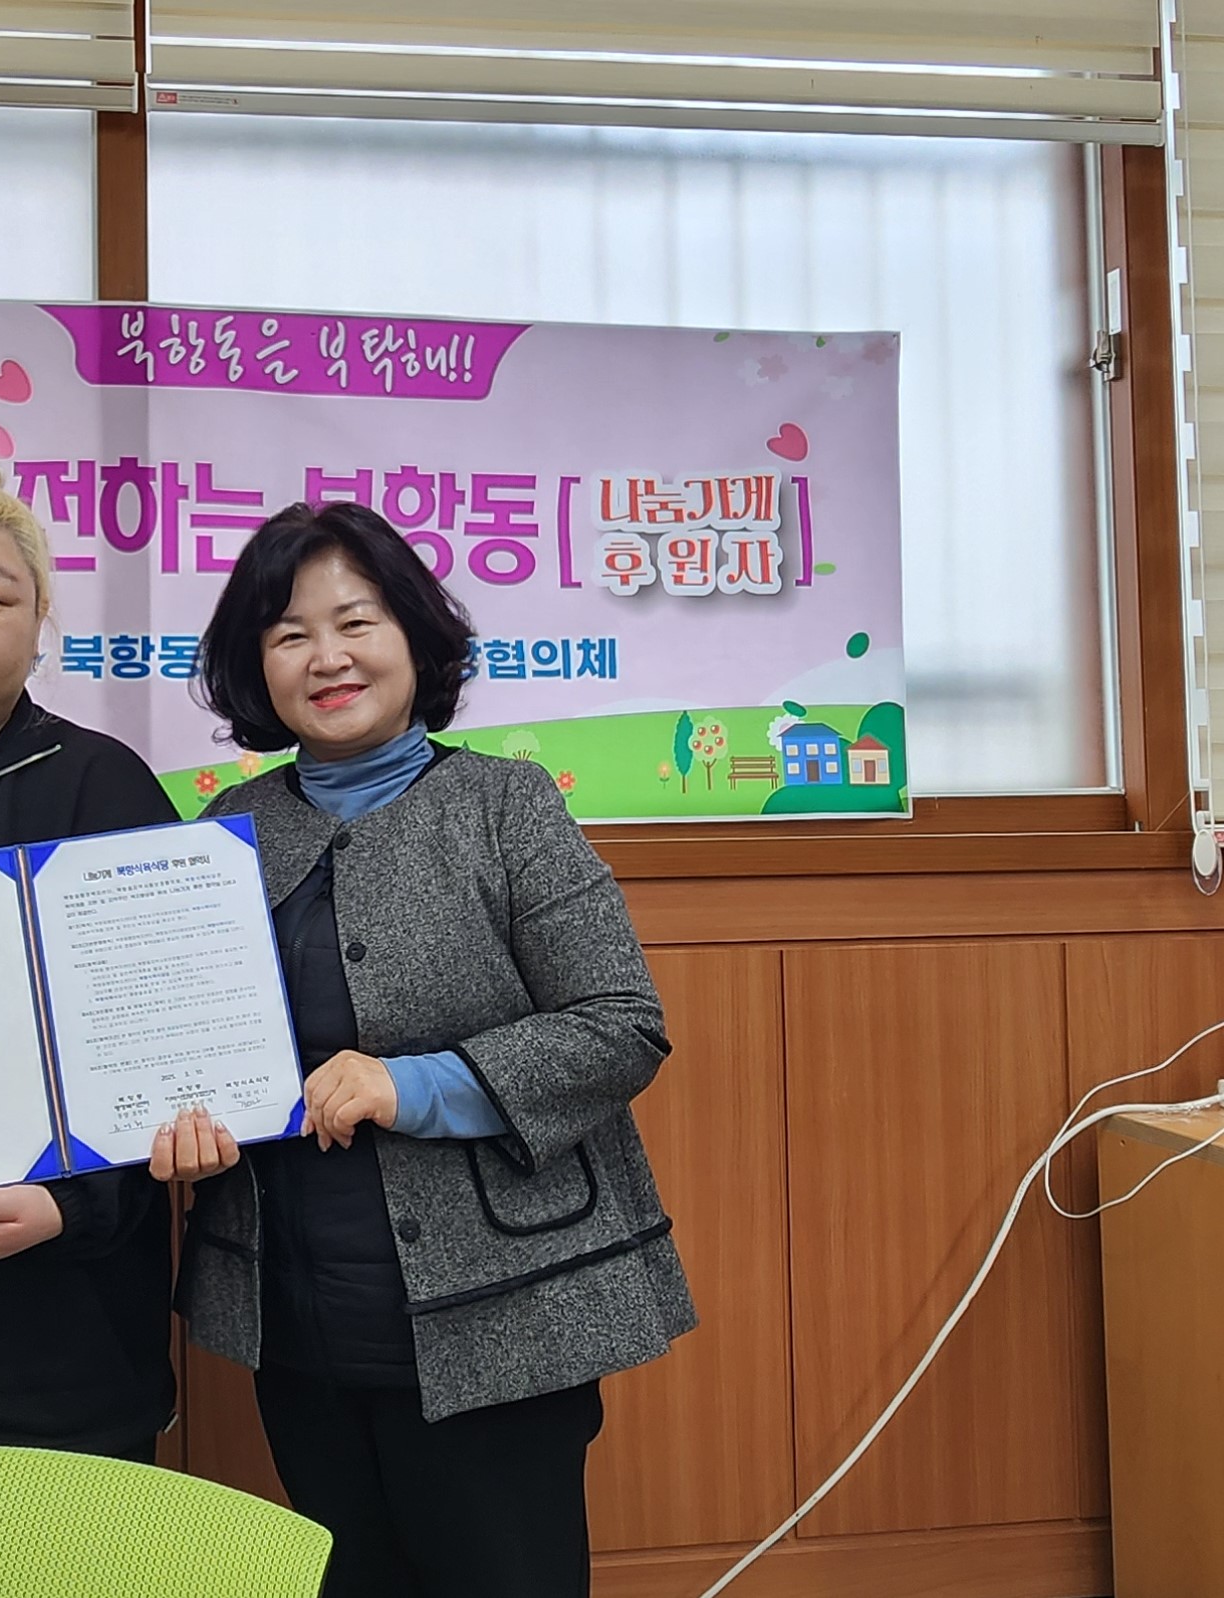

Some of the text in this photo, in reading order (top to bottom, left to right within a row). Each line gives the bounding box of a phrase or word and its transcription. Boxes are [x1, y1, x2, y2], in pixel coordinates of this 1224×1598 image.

[117, 311, 299, 385] 북항동을
[599, 475, 775, 524] 나눔가게
[601, 537, 775, 587] 후원자
[59, 633, 203, 680] 북항동
